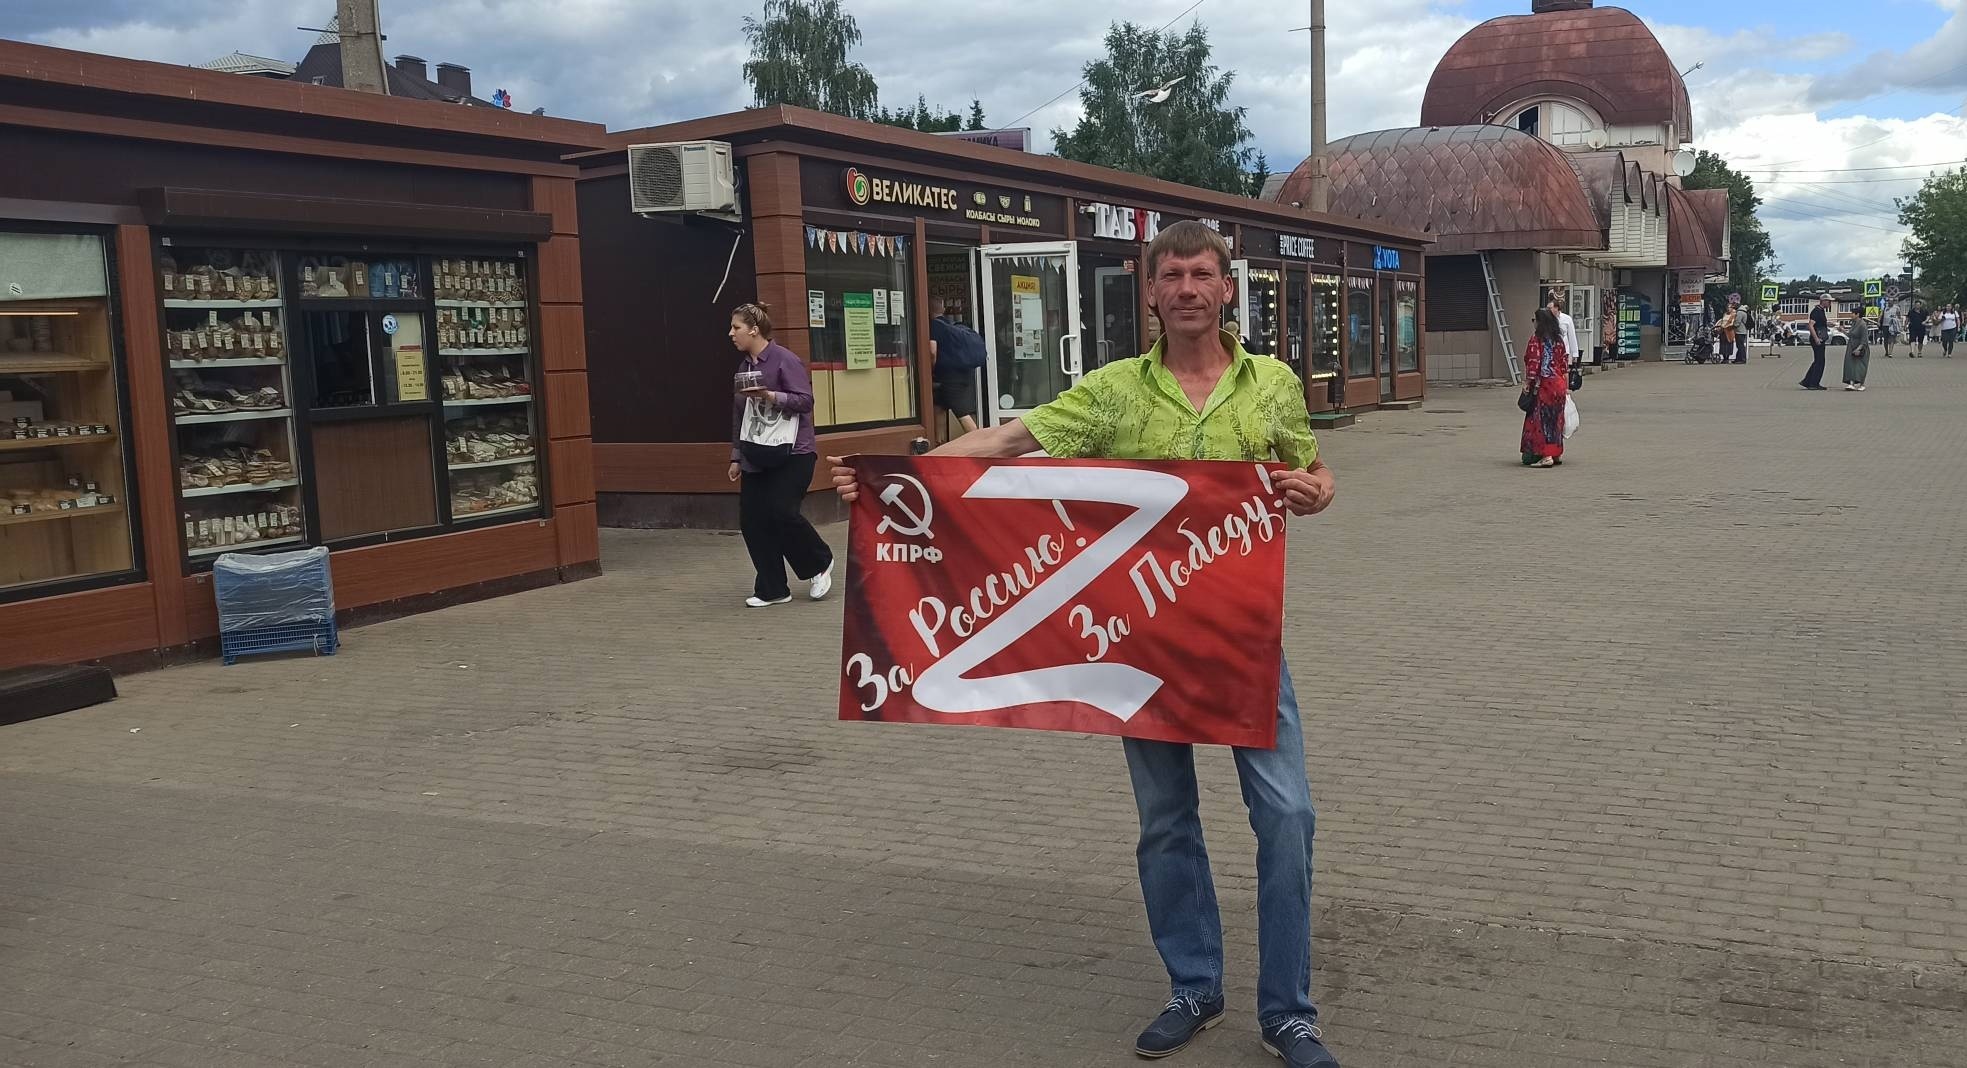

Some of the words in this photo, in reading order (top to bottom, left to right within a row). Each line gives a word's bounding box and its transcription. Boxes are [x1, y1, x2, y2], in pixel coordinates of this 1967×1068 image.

[872, 178, 958, 210] ВЕЛИКАТЕС
[966, 209, 996, 222] КОЛБАСЫ
[997, 213, 1015, 224] СЫРЫ
[1016, 216, 1041, 228] МОЛОКО
[1283, 235, 1298, 257] PRICE
[1297, 237, 1315, 259] COFFEE
[1383, 248, 1400, 269] YOTA
[876, 542, 943, 564] КПРФ
[1068, 603, 1131, 662] За
[1128, 463, 1286, 618] Победу!
[846, 652, 915, 712] За
[908, 499, 1087, 658] Россию!
